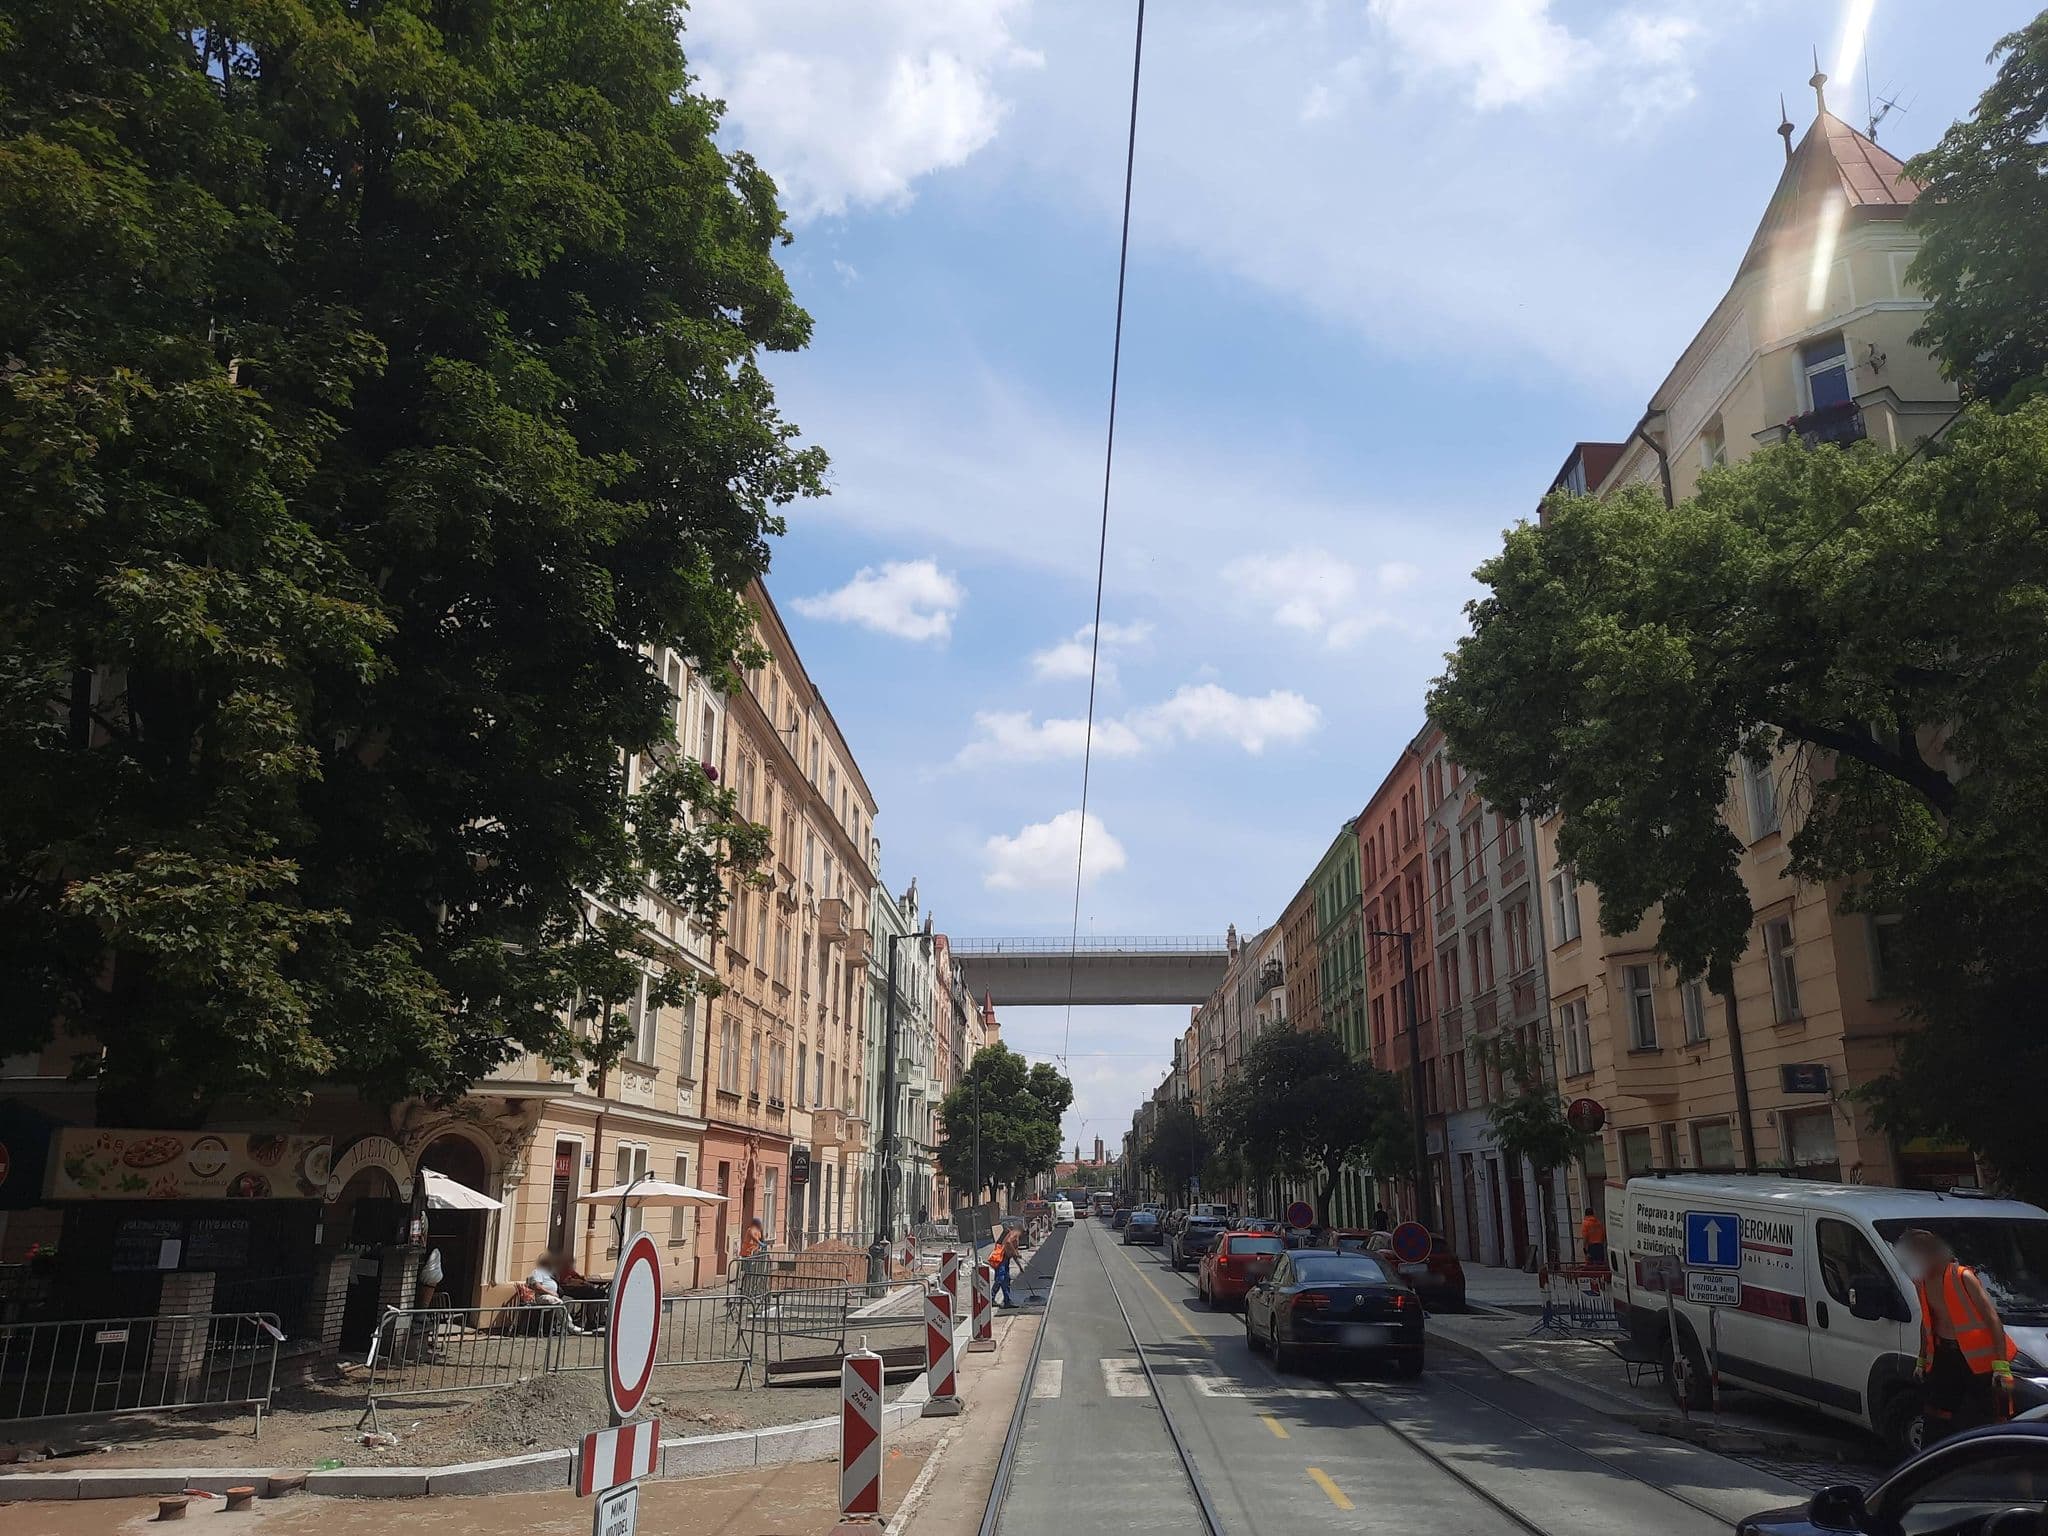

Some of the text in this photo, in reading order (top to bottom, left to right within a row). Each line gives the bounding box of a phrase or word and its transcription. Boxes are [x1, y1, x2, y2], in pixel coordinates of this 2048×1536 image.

[1637, 1202, 1668, 1220] Přeprava
[1669, 1210, 1674, 1221] a
[1657, 1224, 1683, 1240] asfaltu
[1636, 1239, 1642, 1249] a
[1690, 1292, 1695, 1300] V
[850, 1391, 868, 1412] Znak
[858, 1386, 874, 1402] TOP
[610, 1497, 628, 1520] MIMO
